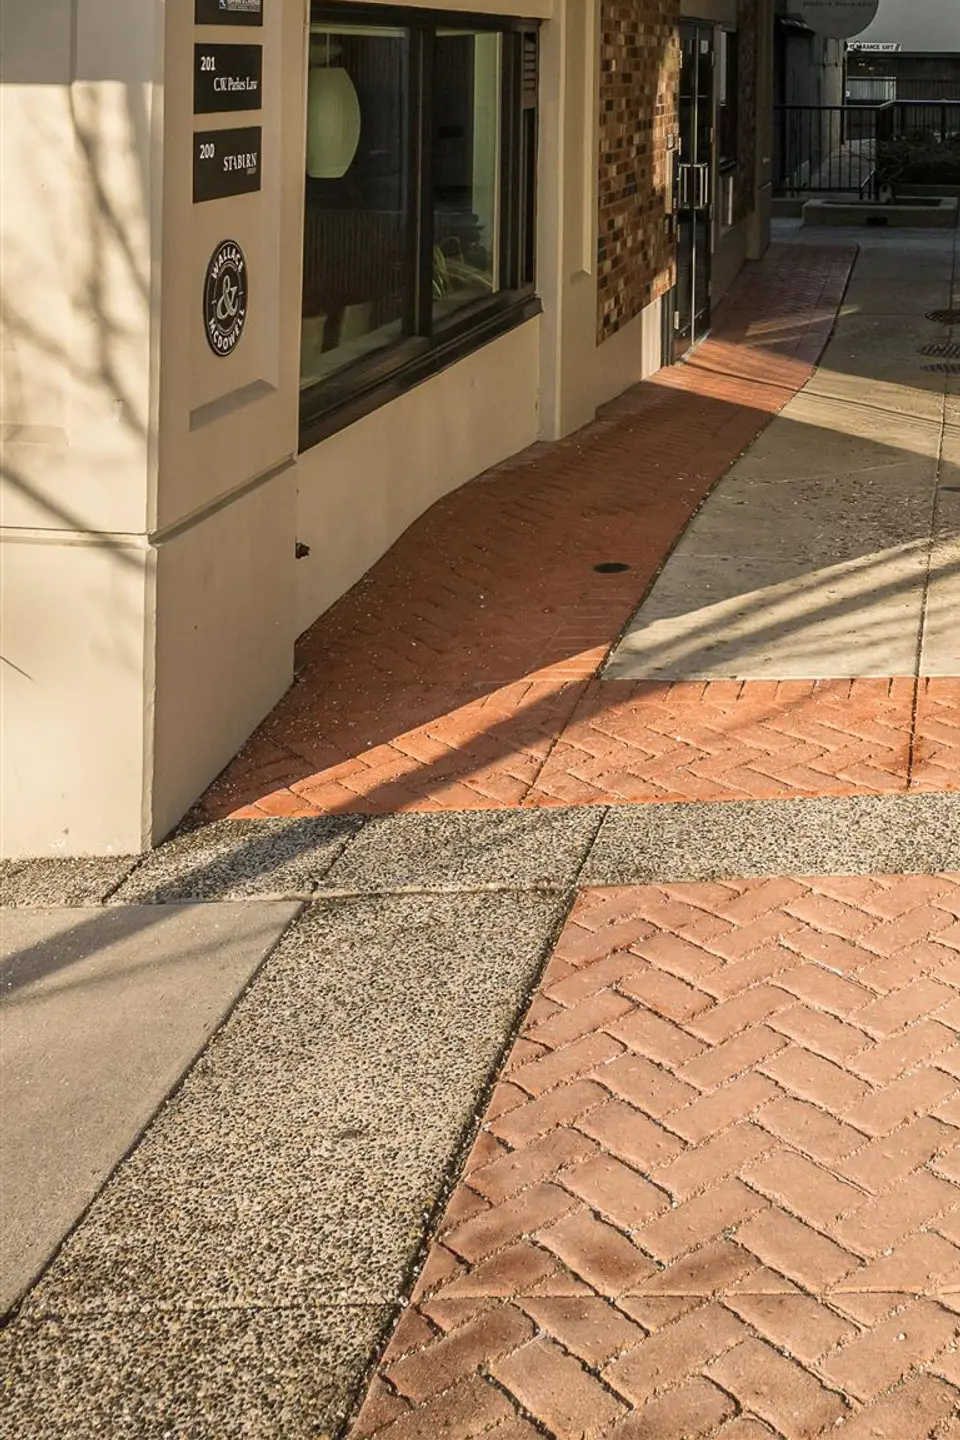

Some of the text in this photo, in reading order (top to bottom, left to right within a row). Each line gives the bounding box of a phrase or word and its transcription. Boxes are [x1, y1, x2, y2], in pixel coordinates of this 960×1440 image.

[200, 56, 216, 71] 201
[199, 143, 215, 159] 200
[211, 246, 243, 279] WALLACE
[216, 275, 238, 319] &
